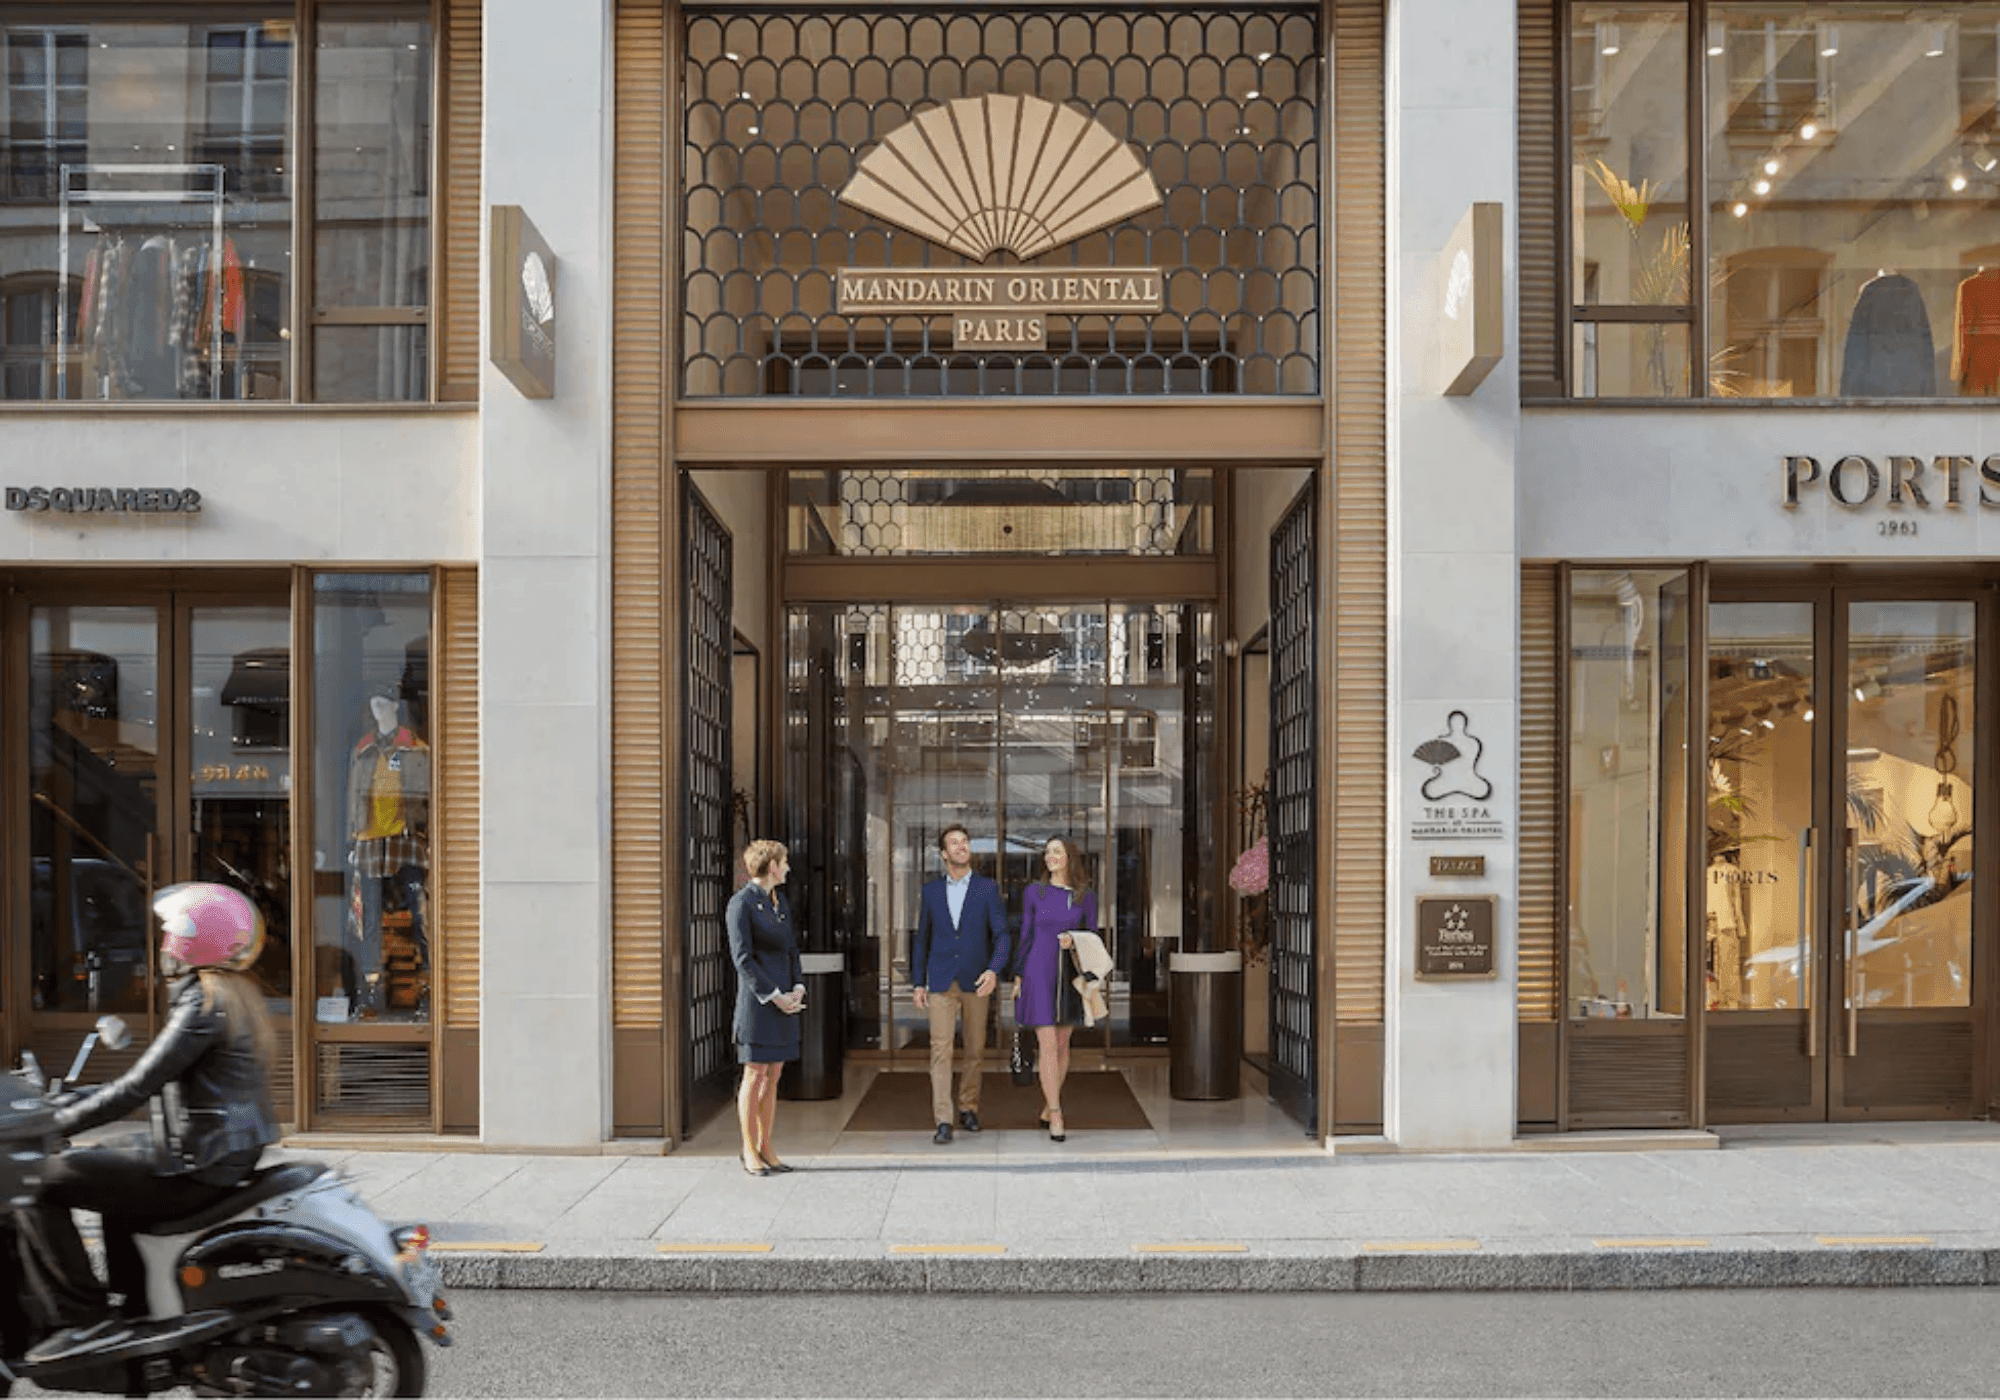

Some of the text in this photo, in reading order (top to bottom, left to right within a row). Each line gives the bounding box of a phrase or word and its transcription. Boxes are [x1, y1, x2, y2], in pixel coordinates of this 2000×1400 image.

[842, 278, 1158, 302] MANDARIN ORIENTAL
[958, 318, 1042, 342] PARIS
[1784, 454, 2000, 508] PORTS
[5, 486, 202, 513] DSQUARED2
[1878, 520, 1918, 536] 1961
[1424, 807, 1491, 819] THE SPA
[1713, 870, 1779, 884] PORTS
